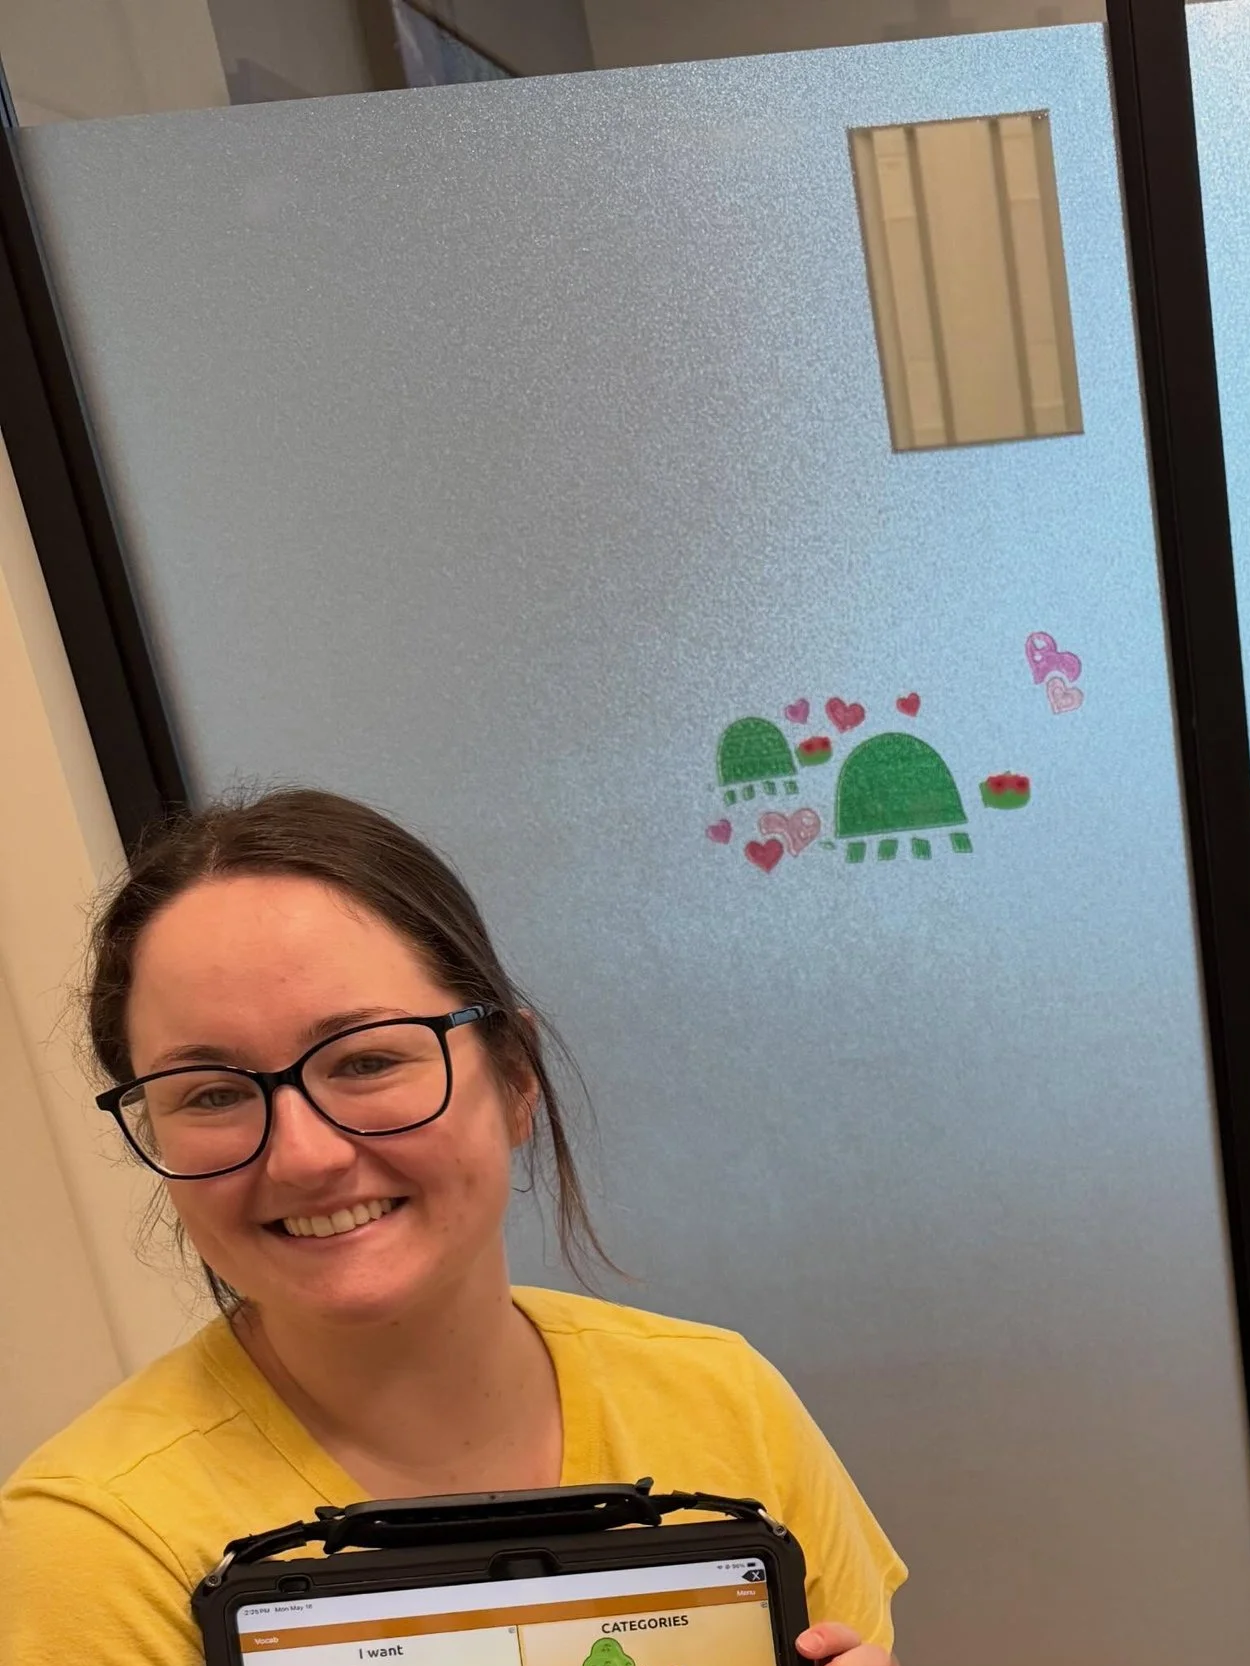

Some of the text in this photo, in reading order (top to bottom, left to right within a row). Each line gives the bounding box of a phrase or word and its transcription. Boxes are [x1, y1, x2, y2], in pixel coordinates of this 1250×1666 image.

[602, 1615, 689, 1633] CATEGORIES
[254, 1637, 279, 1645] Vocab
[359, 1645, 403, 1659] I want
